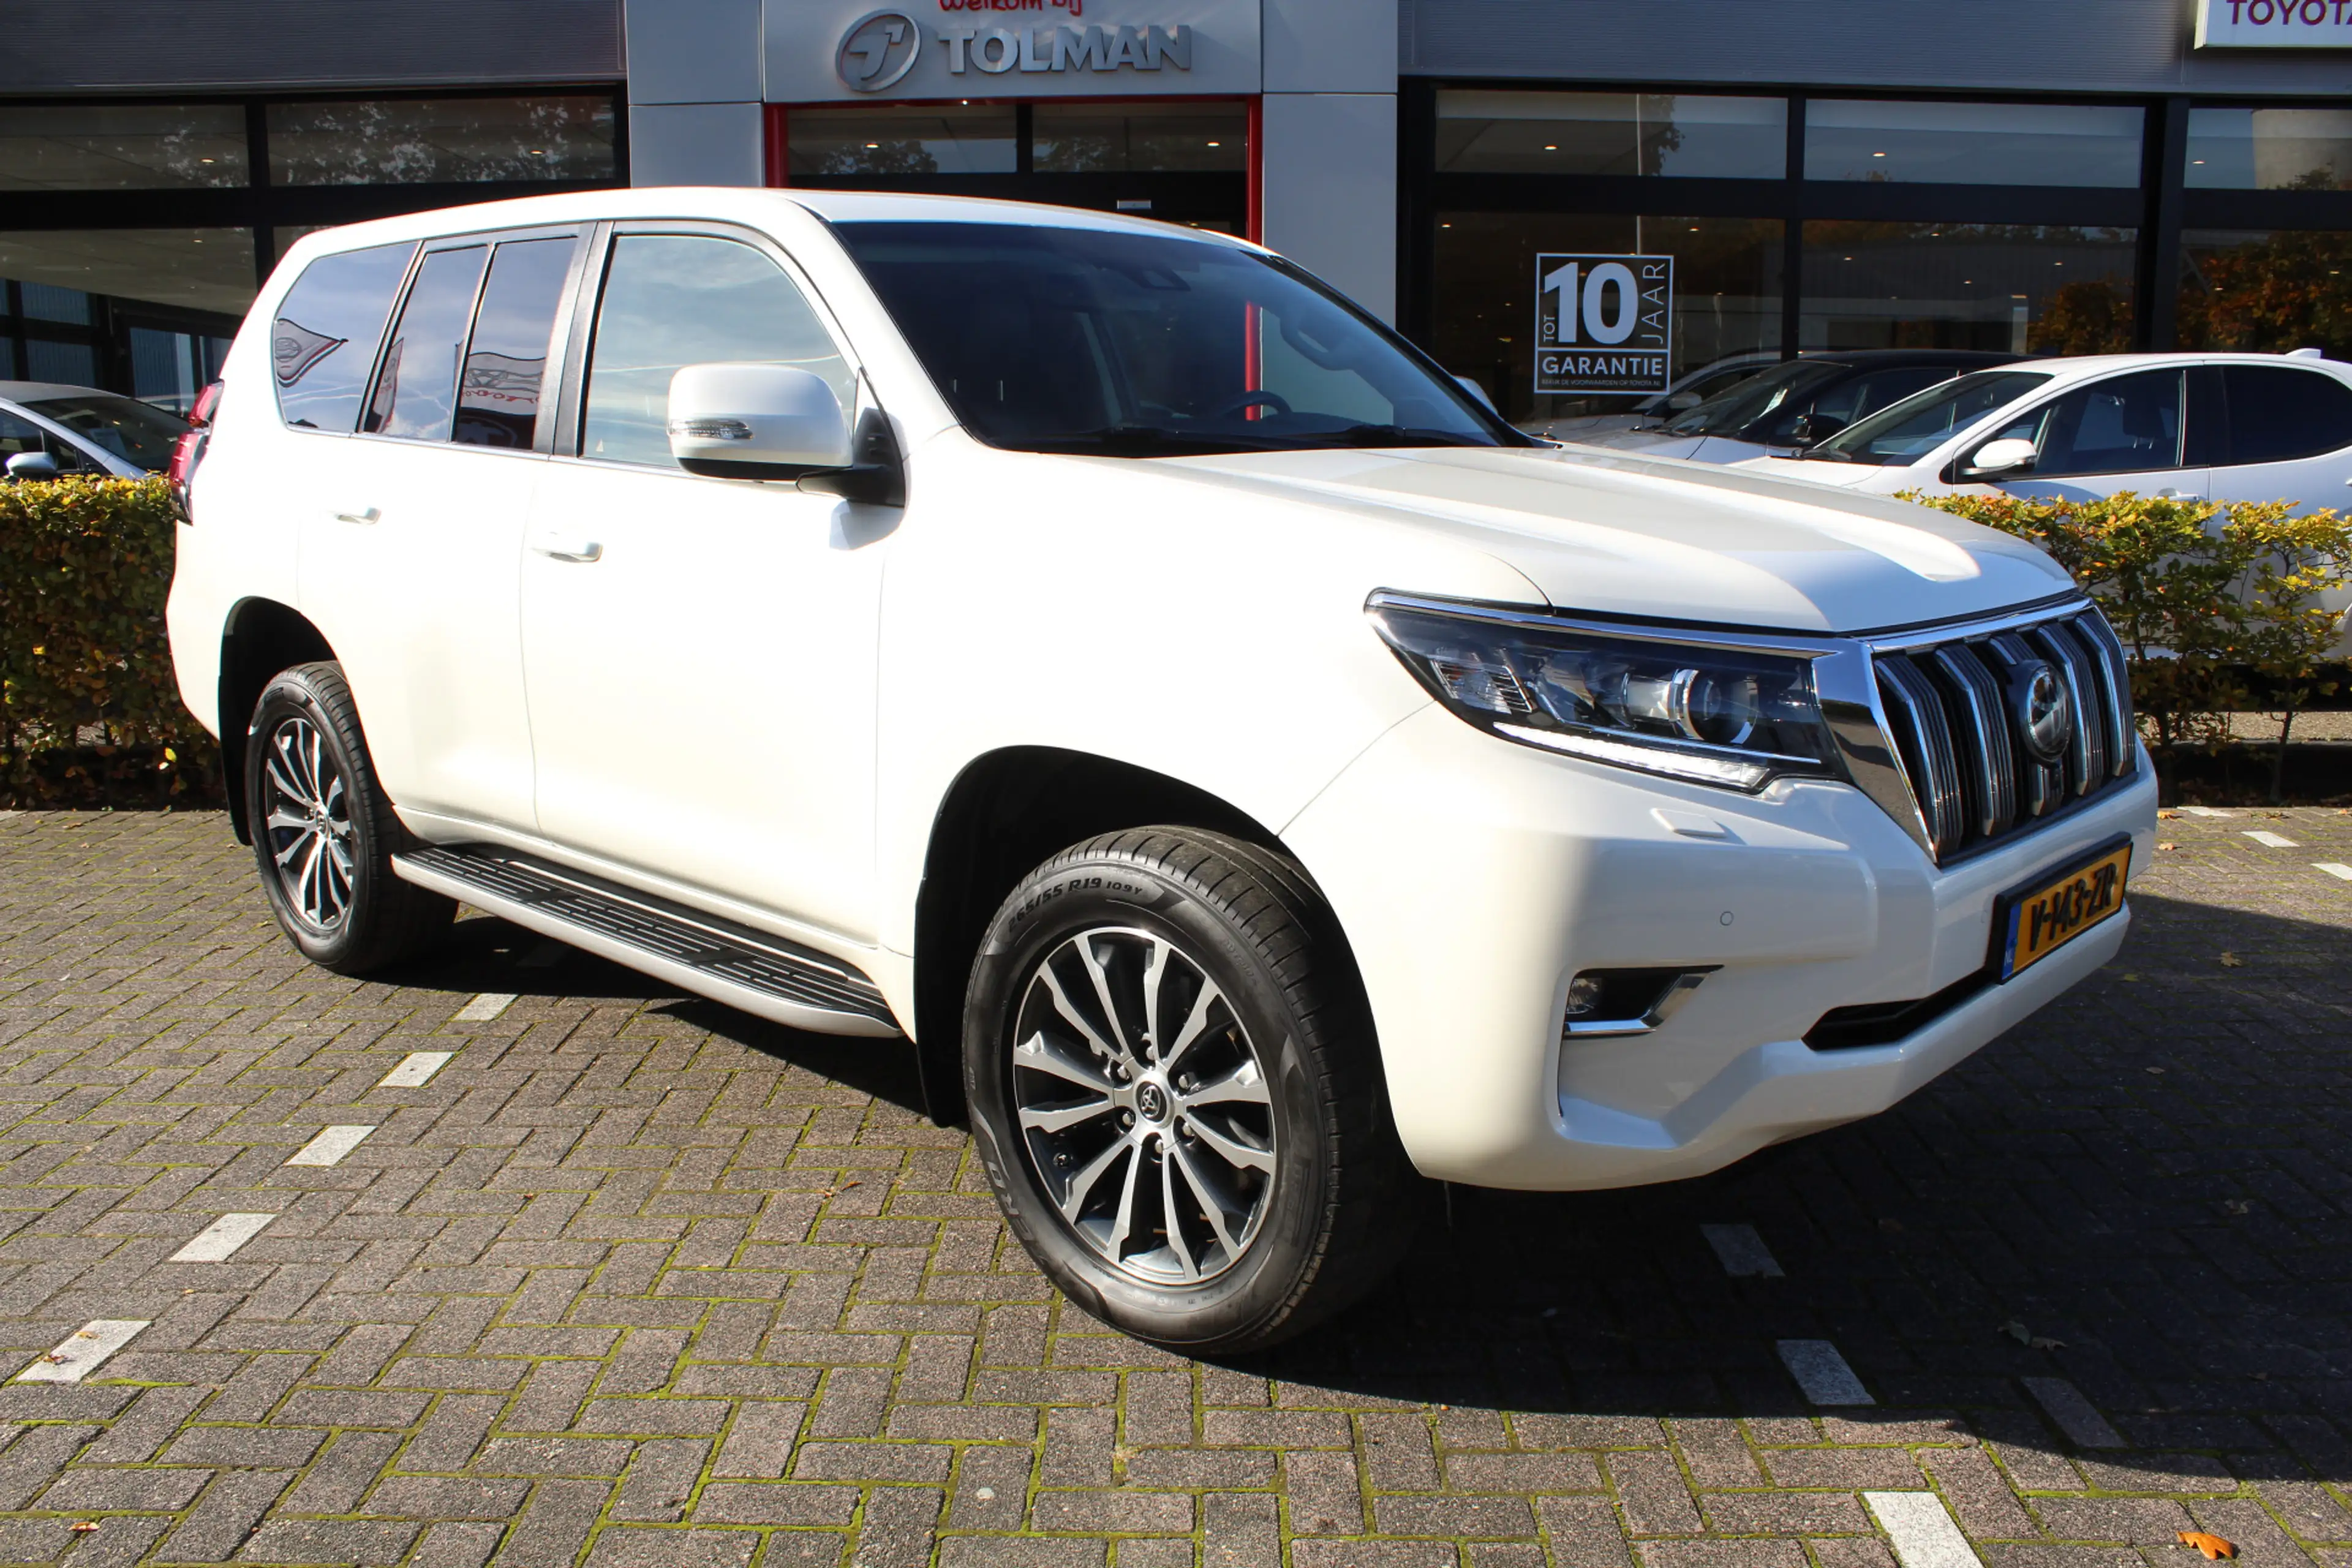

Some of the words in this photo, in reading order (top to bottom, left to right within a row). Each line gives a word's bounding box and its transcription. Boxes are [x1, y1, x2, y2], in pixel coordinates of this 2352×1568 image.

[2226, 0, 2352, 25] TOYOT
[938, 24, 1191, 74] TOLMAN
[1544, 262, 1638, 344] 10
[1641, 263, 1665, 344] JAAR
[1544, 315, 1555, 342] TOT
[1542, 356, 1663, 375] GARANTIE
[1008, 883, 1063, 933] 265/55
[1068, 877, 1102, 892] R19
[1106, 881, 1143, 895] 109Y
